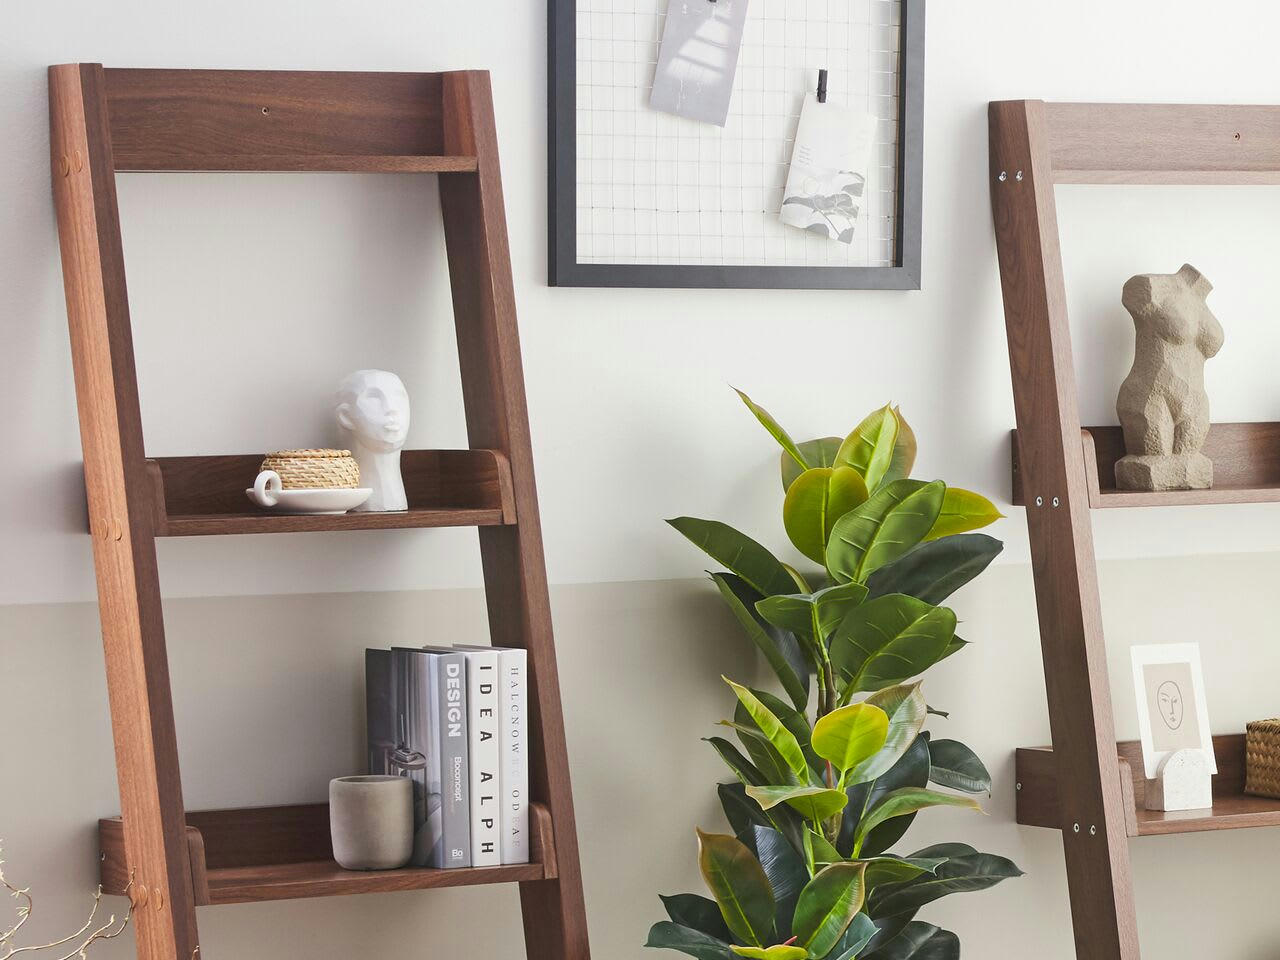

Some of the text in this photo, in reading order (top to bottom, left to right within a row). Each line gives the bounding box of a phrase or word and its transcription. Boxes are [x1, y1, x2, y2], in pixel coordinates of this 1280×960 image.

[446, 663, 462, 737] DESIGN
[479, 666, 494, 854] IDEA ALPH
